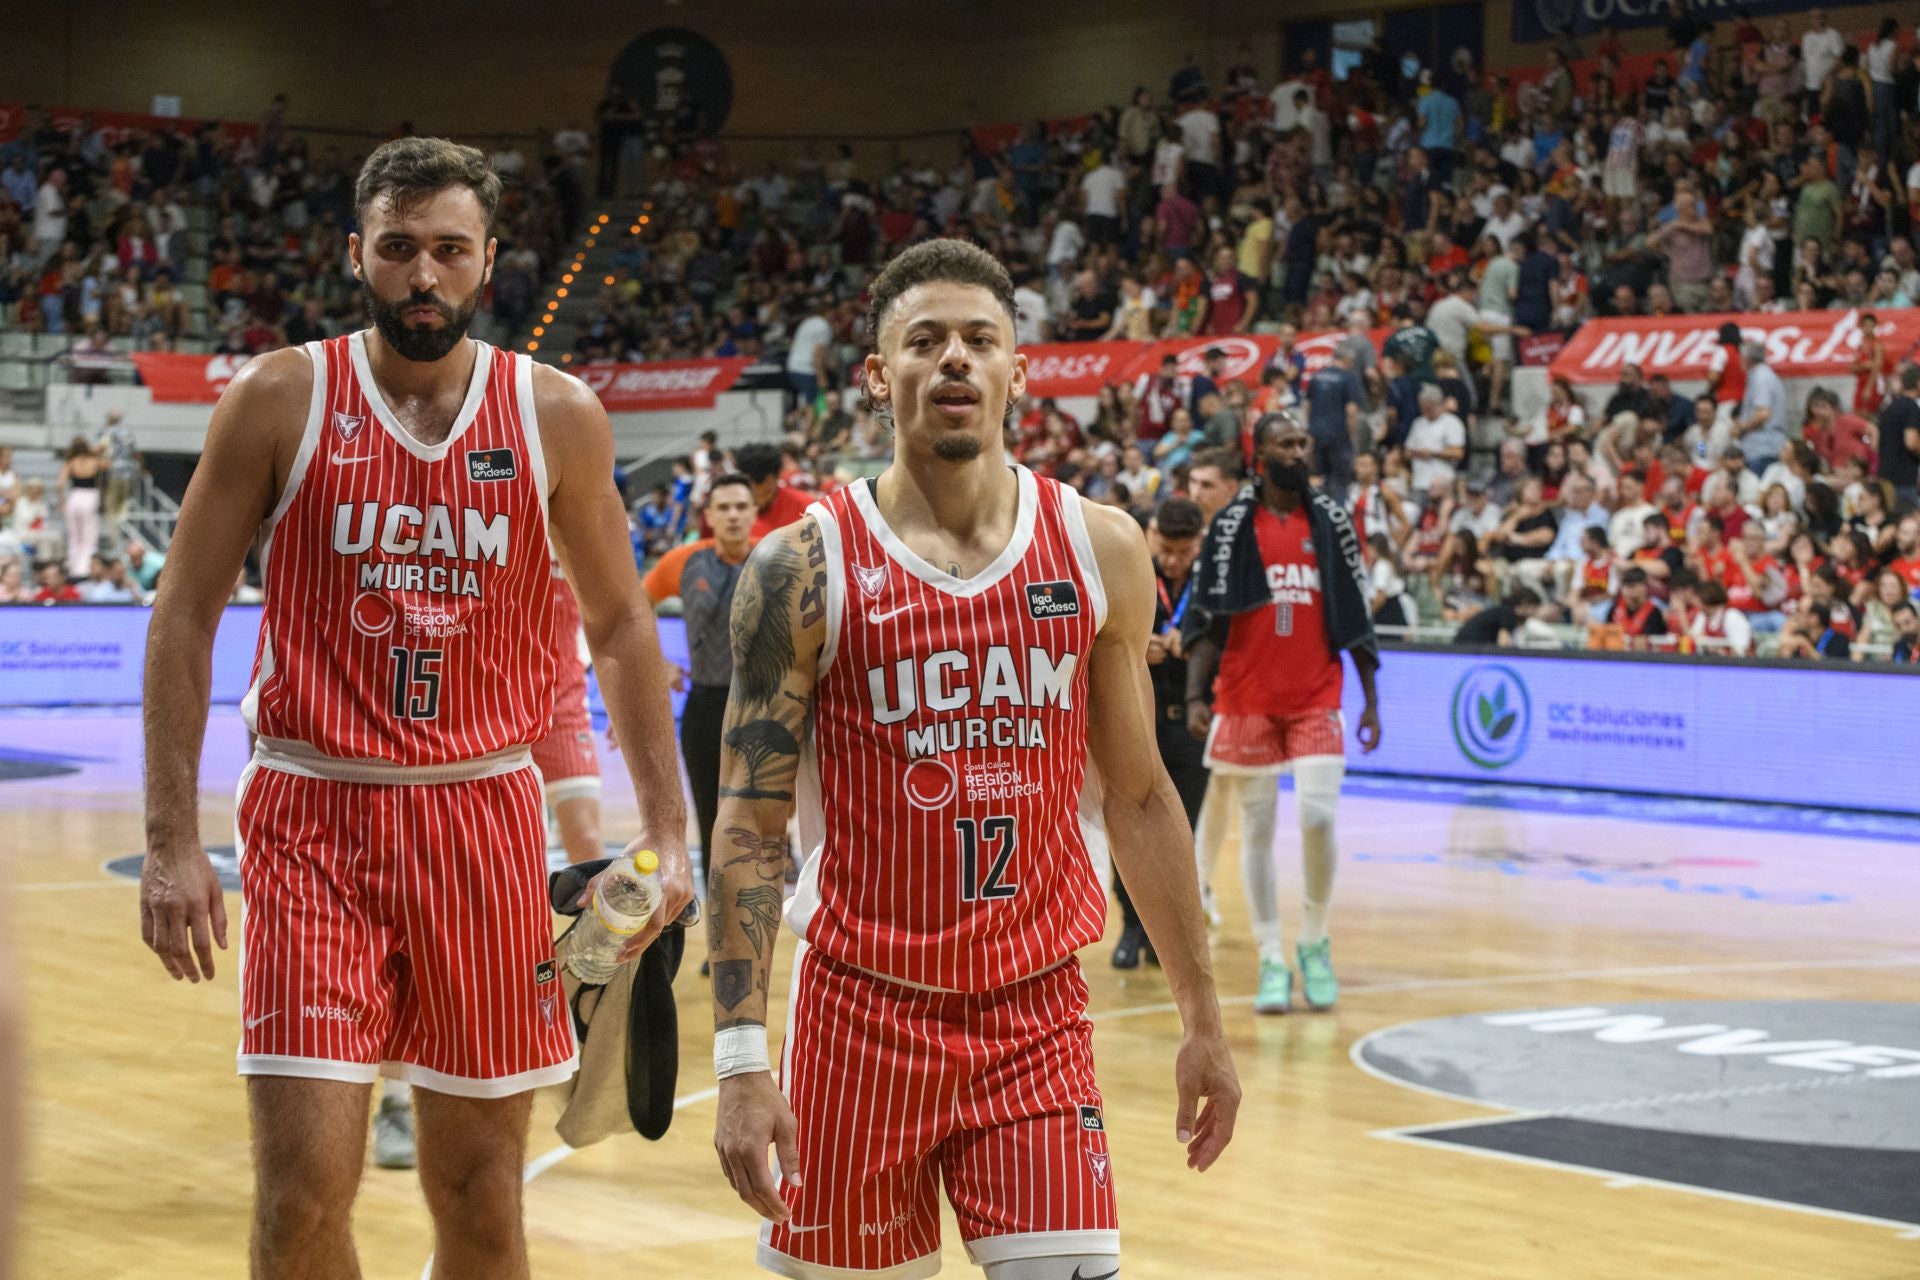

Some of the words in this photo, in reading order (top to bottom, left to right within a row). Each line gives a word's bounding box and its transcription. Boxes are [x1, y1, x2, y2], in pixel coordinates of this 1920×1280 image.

[1583, 308, 1882, 368] INVESUS
[472, 460, 490, 470] liga
[474, 468, 513, 478] endesa
[333, 501, 510, 568] UCAM
[360, 562, 482, 598] MURCIA
[1266, 563, 1321, 592] CAM
[1031, 594, 1052, 605] liga
[1034, 602, 1076, 614] endesa
[405, 612, 455, 625] REGIÓN
[404, 624, 421, 636] DE
[426, 623, 468, 638] MURCIA
[390, 646, 444, 720] 15
[867, 645, 1077, 725] UCAM
[906, 716, 1047, 760] MURCIA
[965, 769, 1022, 788] REGIÓN
[967, 788, 988, 802] DE
[992, 781, 1044, 800] MURCIA
[954, 815, 1018, 902] 12
[537, 968, 552, 981] acb
[301, 1004, 363, 1022] INVERSUS
[1084, 1115, 1100, 1128] acb
